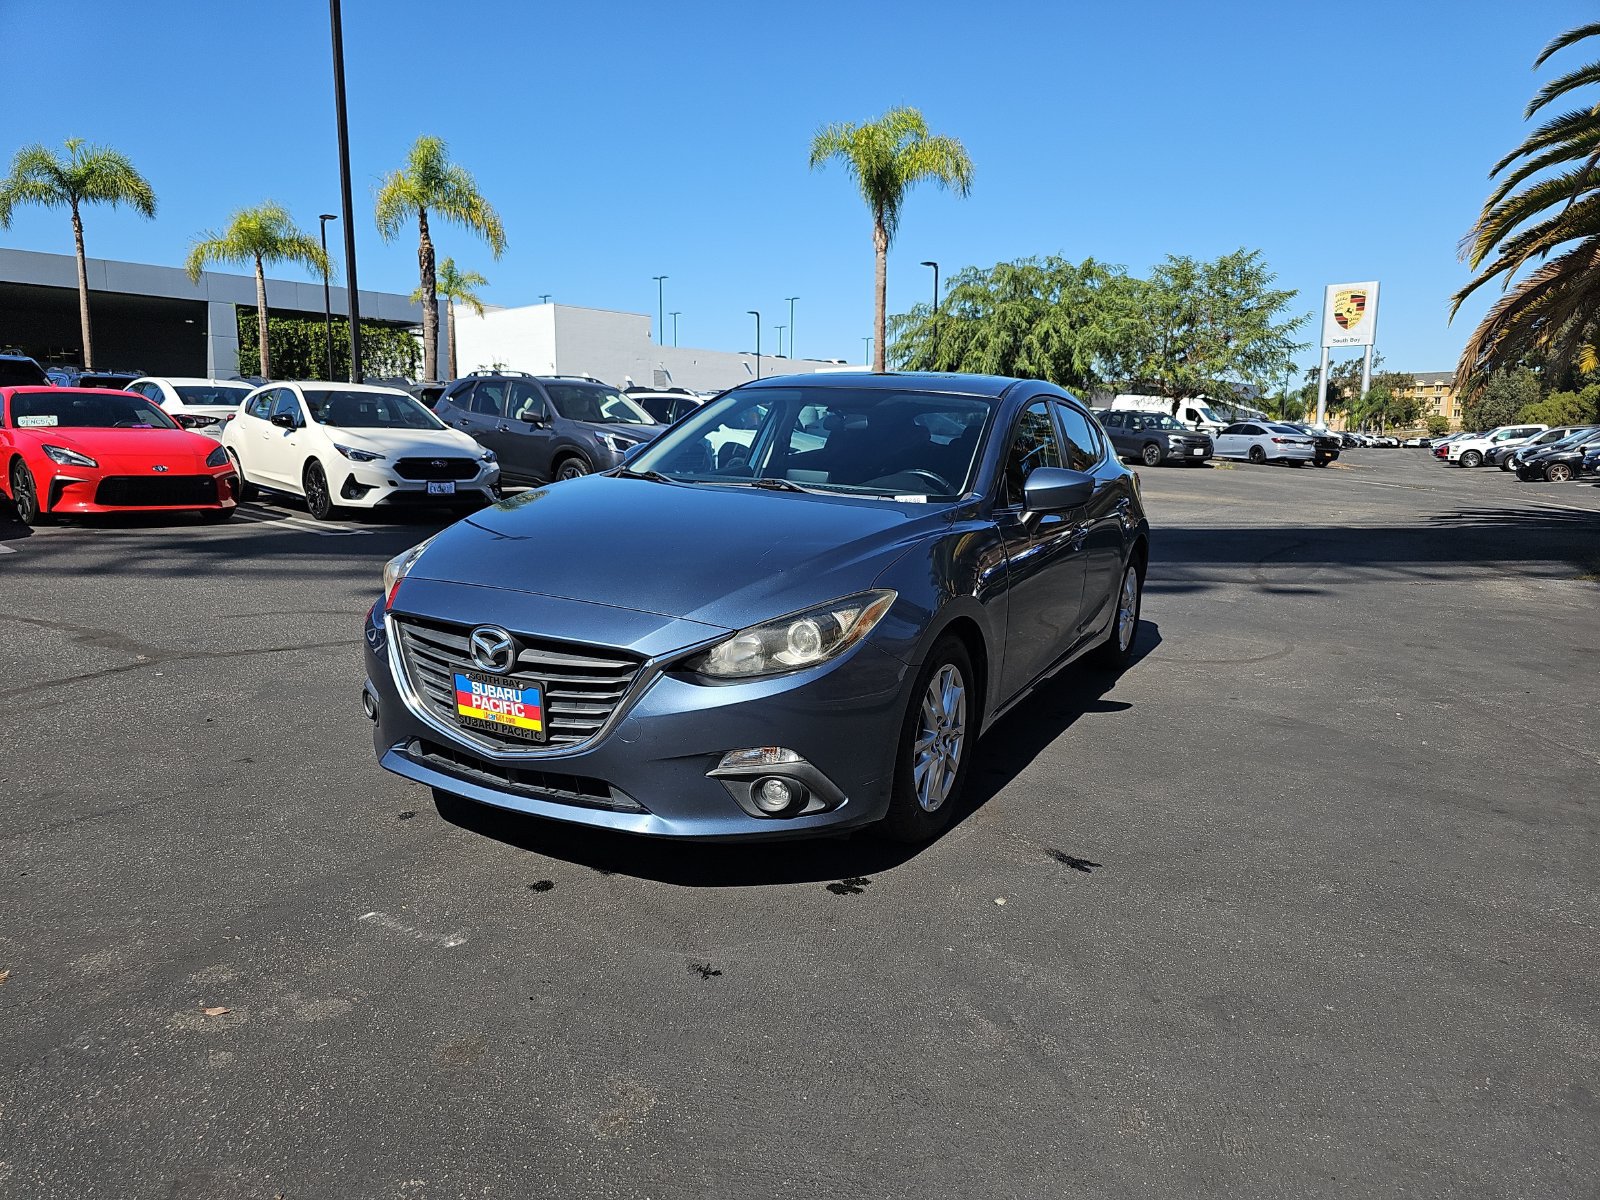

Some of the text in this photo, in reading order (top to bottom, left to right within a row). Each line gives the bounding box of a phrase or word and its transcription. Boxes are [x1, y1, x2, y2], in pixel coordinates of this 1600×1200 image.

[470, 672, 520, 687] SOUTH BAY
[472, 681, 522, 702] SUBARU
[472, 694, 525, 717] PACIFIC
[459, 717, 541, 741] SUBARU PACIFIC
